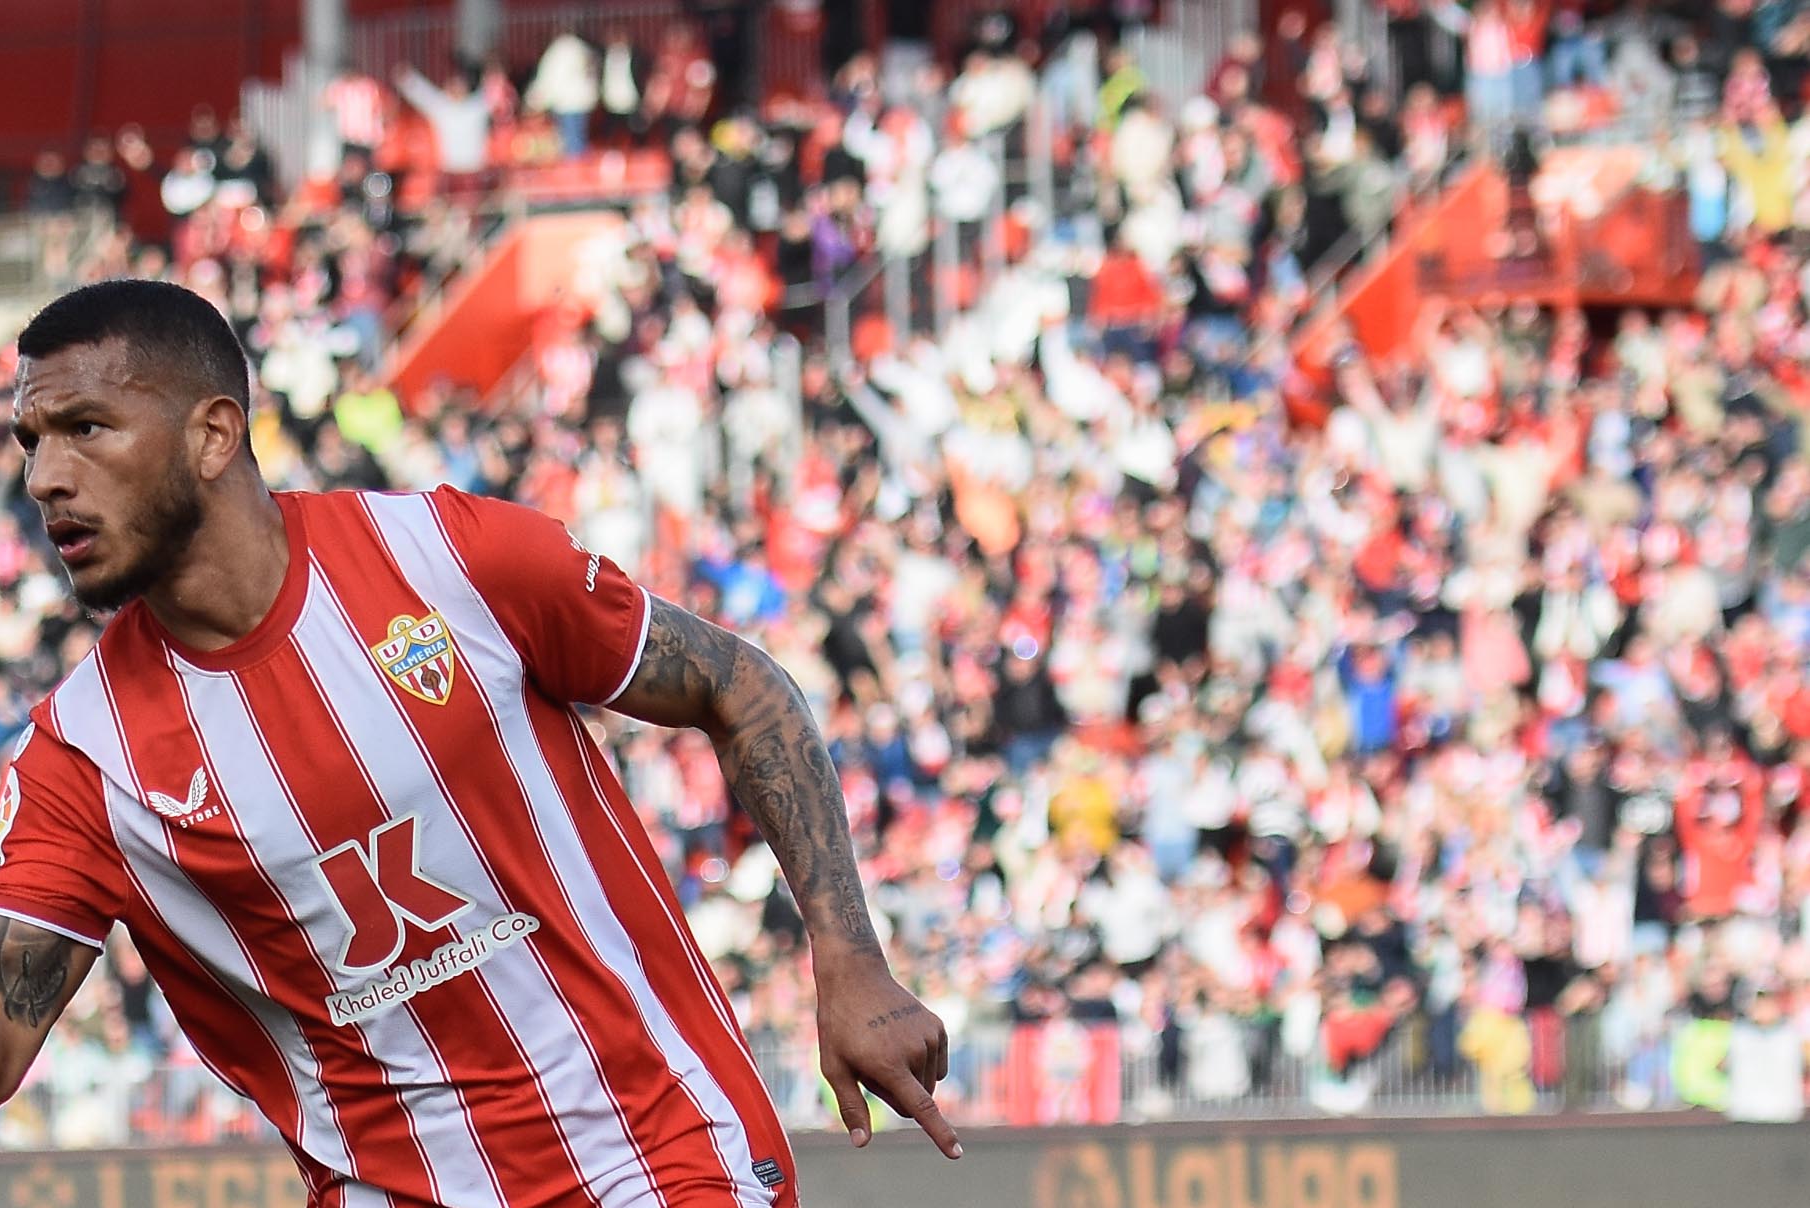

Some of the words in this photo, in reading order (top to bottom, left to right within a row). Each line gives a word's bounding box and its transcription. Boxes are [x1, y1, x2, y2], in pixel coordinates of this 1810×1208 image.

[382, 643, 399, 659] U
[418, 623, 436, 639] D
[392, 641, 447, 676] ALMERIA
[179, 804, 222, 829] STORE
[331, 971, 409, 1020] Khaled
[418, 933, 487, 985] Juffali
[491, 917, 534, 942] Co.
